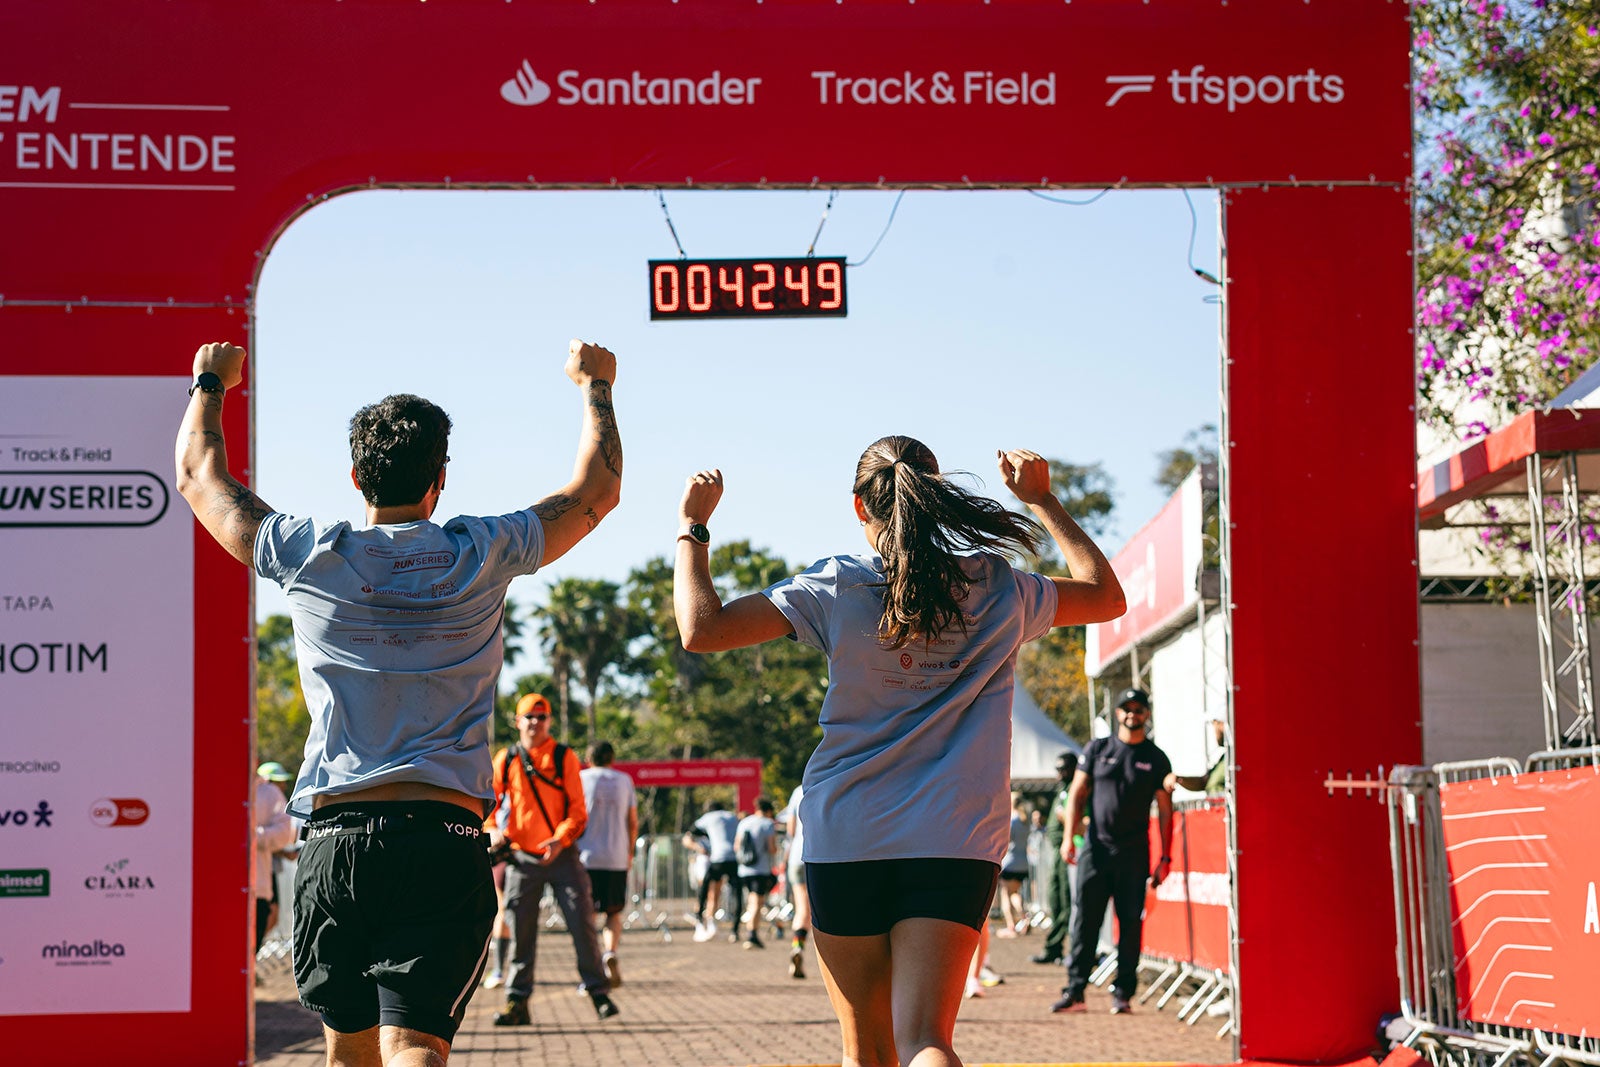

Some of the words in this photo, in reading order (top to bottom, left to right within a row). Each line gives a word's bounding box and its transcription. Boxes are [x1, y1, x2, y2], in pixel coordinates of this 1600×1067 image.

[557, 69, 762, 106] Santander
[1167, 65, 1345, 112] tfsports
[16, 132, 236, 173] ENTENDE
[654, 262, 842, 312] 004249
[918, 661, 938, 669] vivo
[443, 821, 480, 839] YOPP
[84, 876, 156, 890] CLARA
[41, 939, 126, 959] minalba
